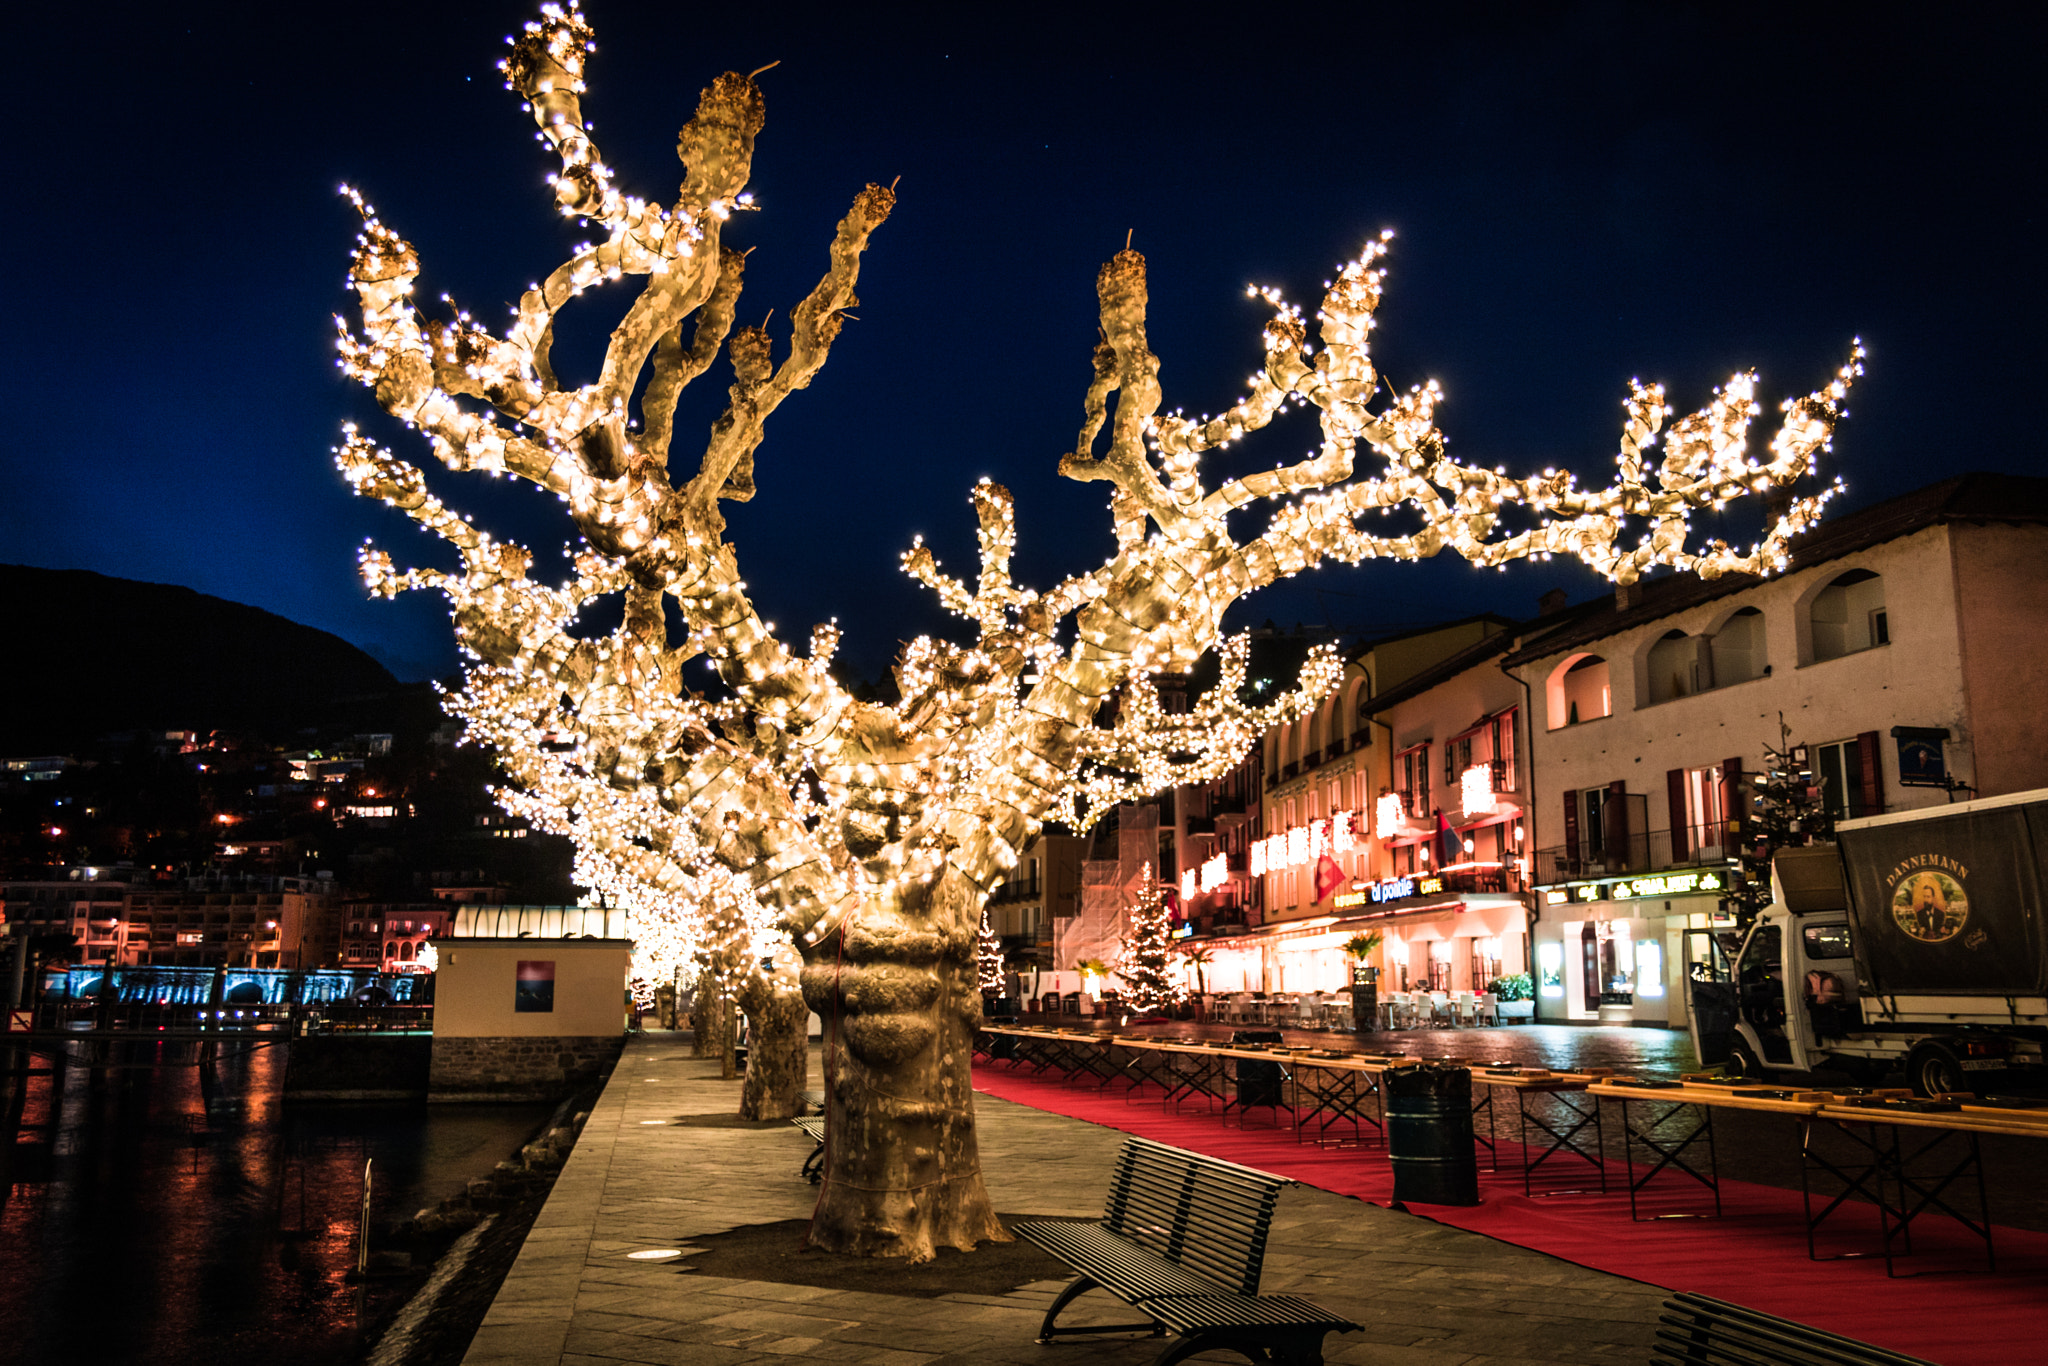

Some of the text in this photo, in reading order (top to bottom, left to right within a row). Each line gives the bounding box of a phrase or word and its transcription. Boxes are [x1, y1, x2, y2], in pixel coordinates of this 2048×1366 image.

[1886, 854, 1969, 887] DANNEMANN
[1382, 878, 1414, 903] pontile
[1632, 877, 1665, 893] CIGAR
